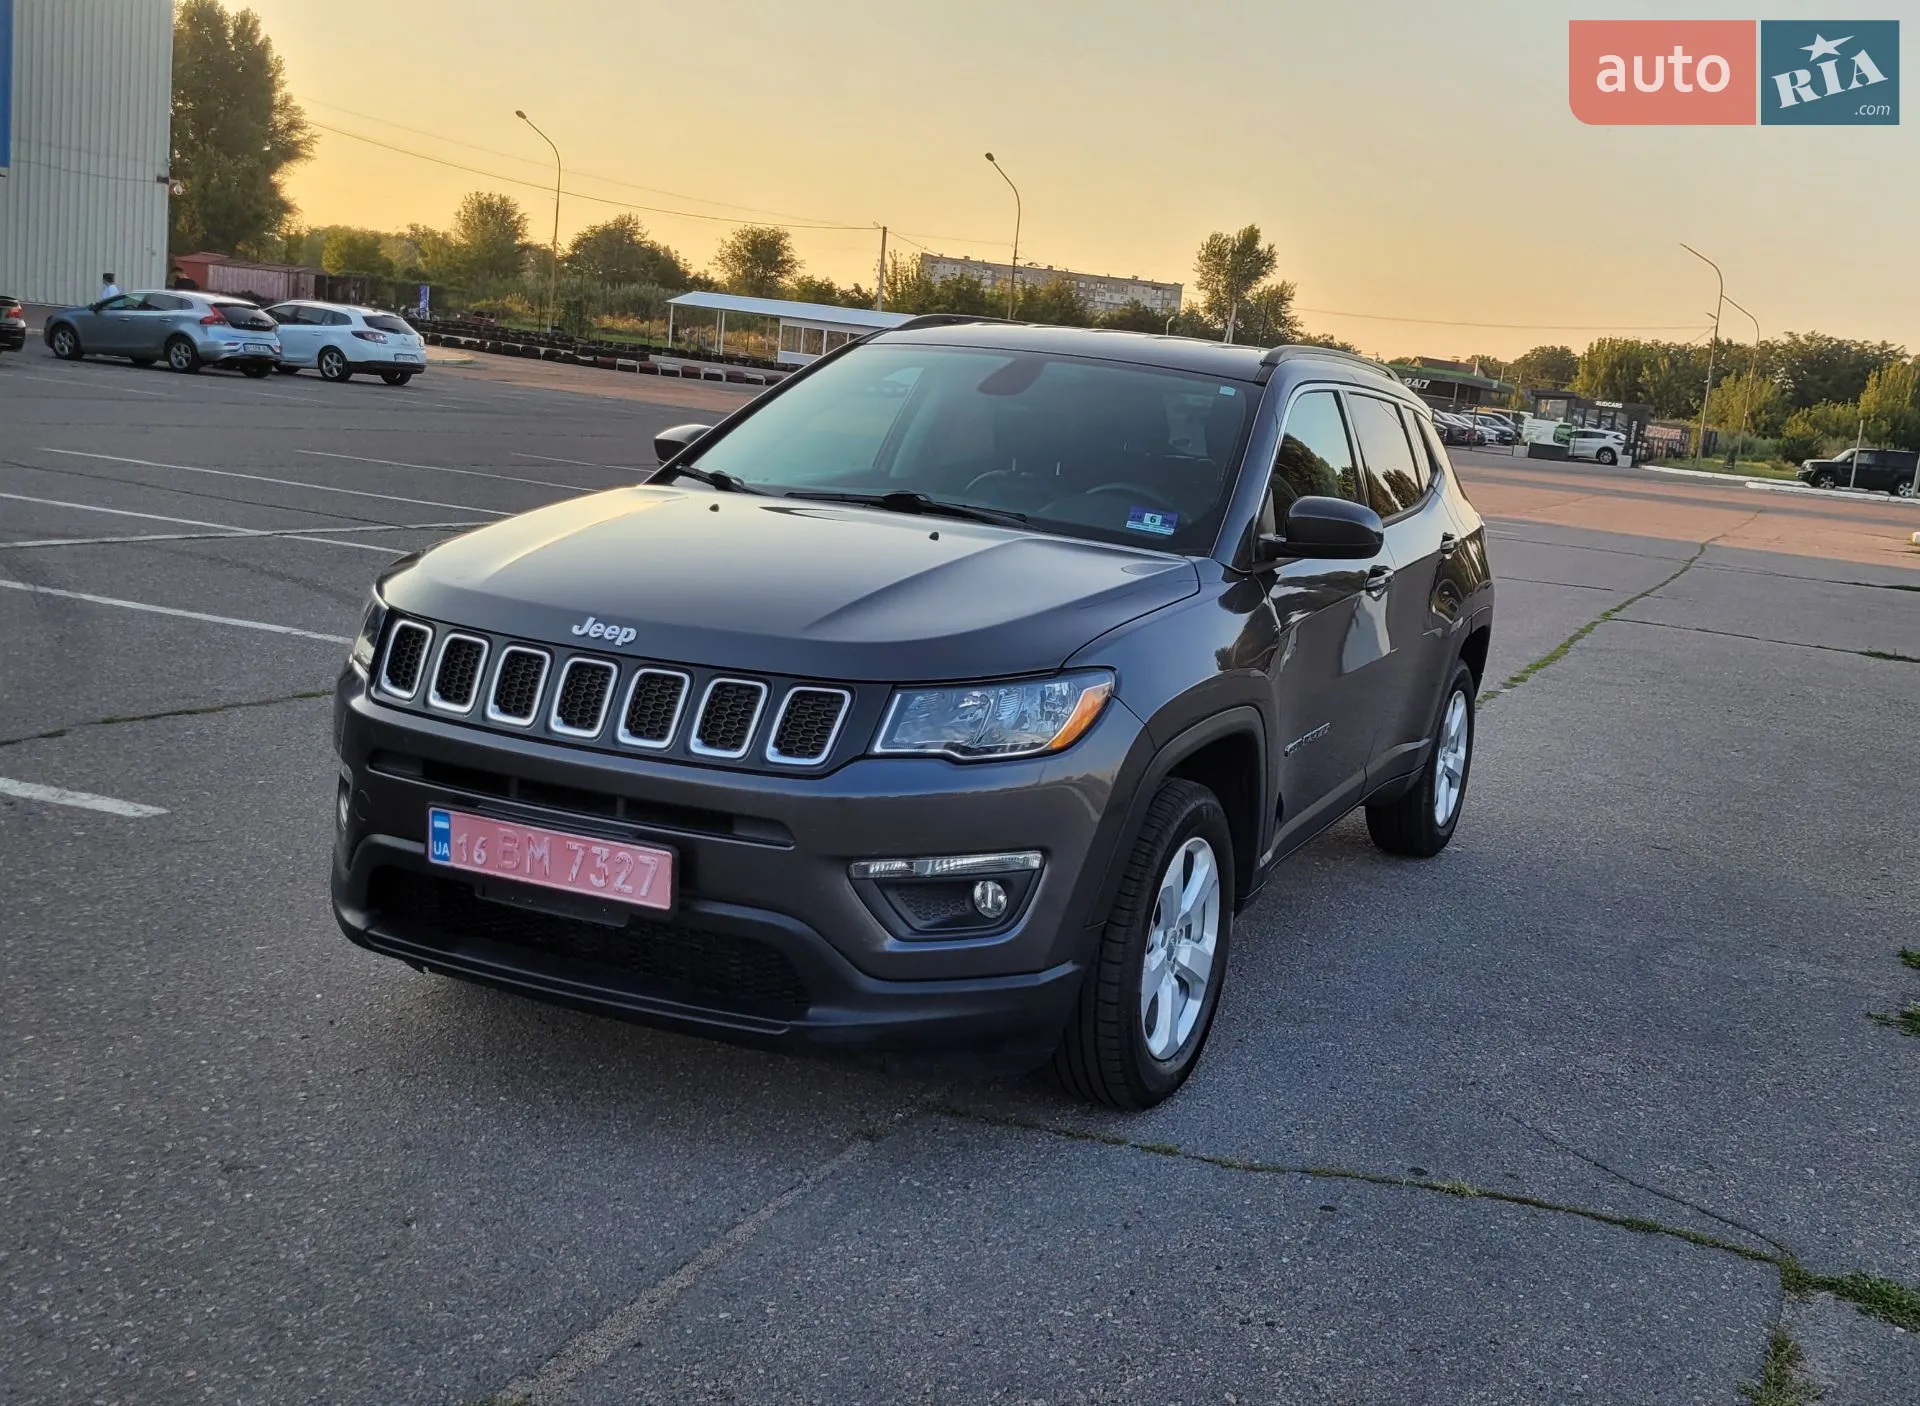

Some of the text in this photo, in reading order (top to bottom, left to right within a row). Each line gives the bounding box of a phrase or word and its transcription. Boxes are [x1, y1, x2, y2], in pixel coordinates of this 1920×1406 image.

[1595, 400, 1623, 409] RUDCARS
[1150, 515, 1157, 523] 6
[572, 616, 637, 646] Jeep
[433, 840, 450, 857] UA
[456, 827, 660, 897] 16 BM 7327
